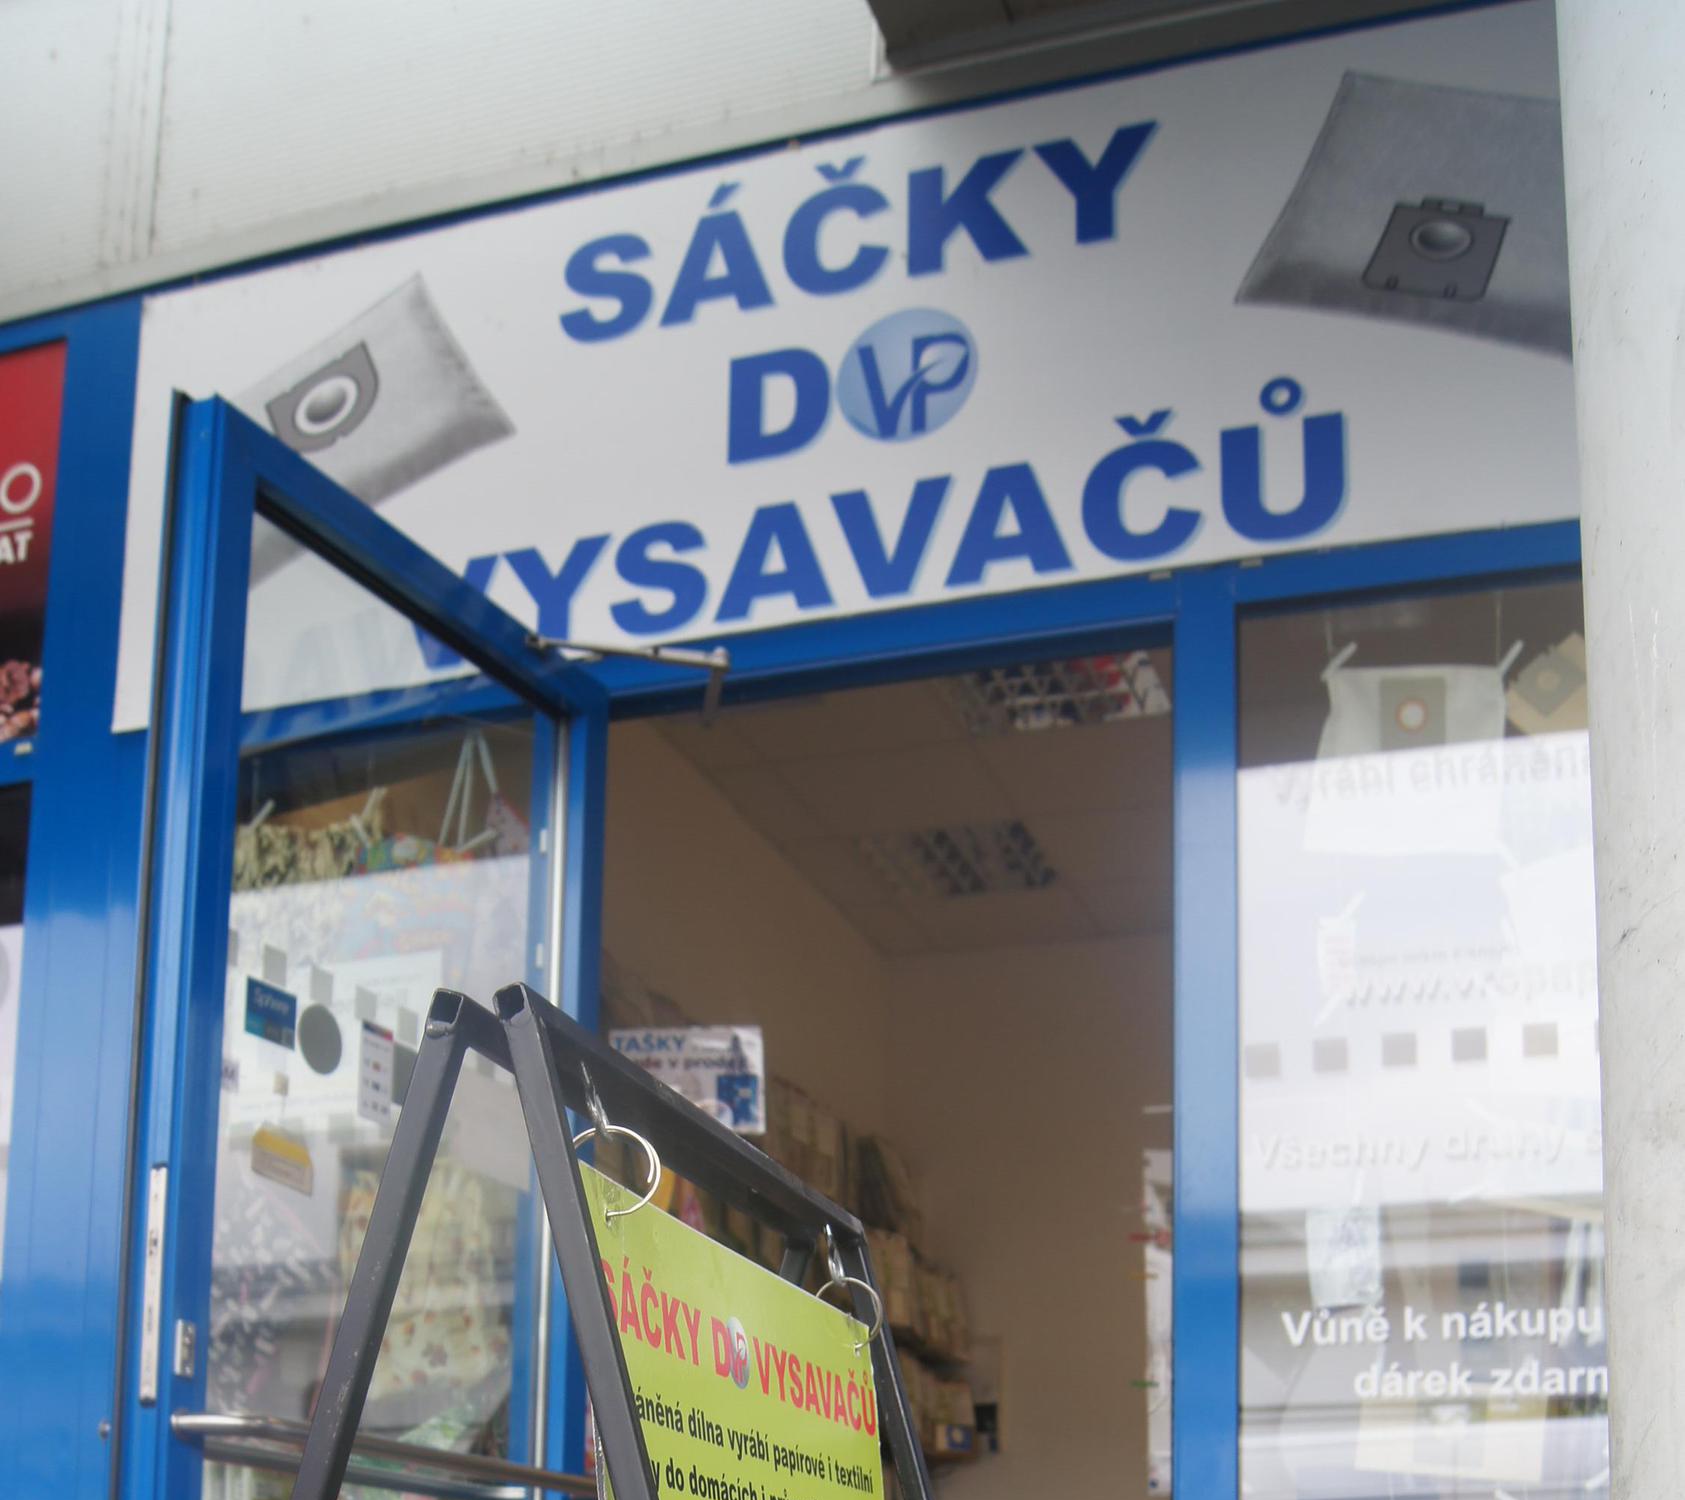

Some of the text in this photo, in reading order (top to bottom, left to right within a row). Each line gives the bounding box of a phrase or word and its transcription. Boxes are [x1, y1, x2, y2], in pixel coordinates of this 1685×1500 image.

[559, 119, 1158, 344] SÁČKY
[1281, 1306, 1389, 1347] Vůně
[1404, 1309, 1429, 1341] k
[753, 1336, 876, 1437] VYSAVAČŮ
[1354, 1361, 1471, 1399] dárek
[634, 1386, 683, 1433] áněná
[688, 1407, 724, 1448] dílna
[728, 1427, 769, 1462] vyrábí
[773, 1444, 826, 1477] papírové
[835, 1459, 874, 1494] textilní
[666, 1457, 684, 1492] do
